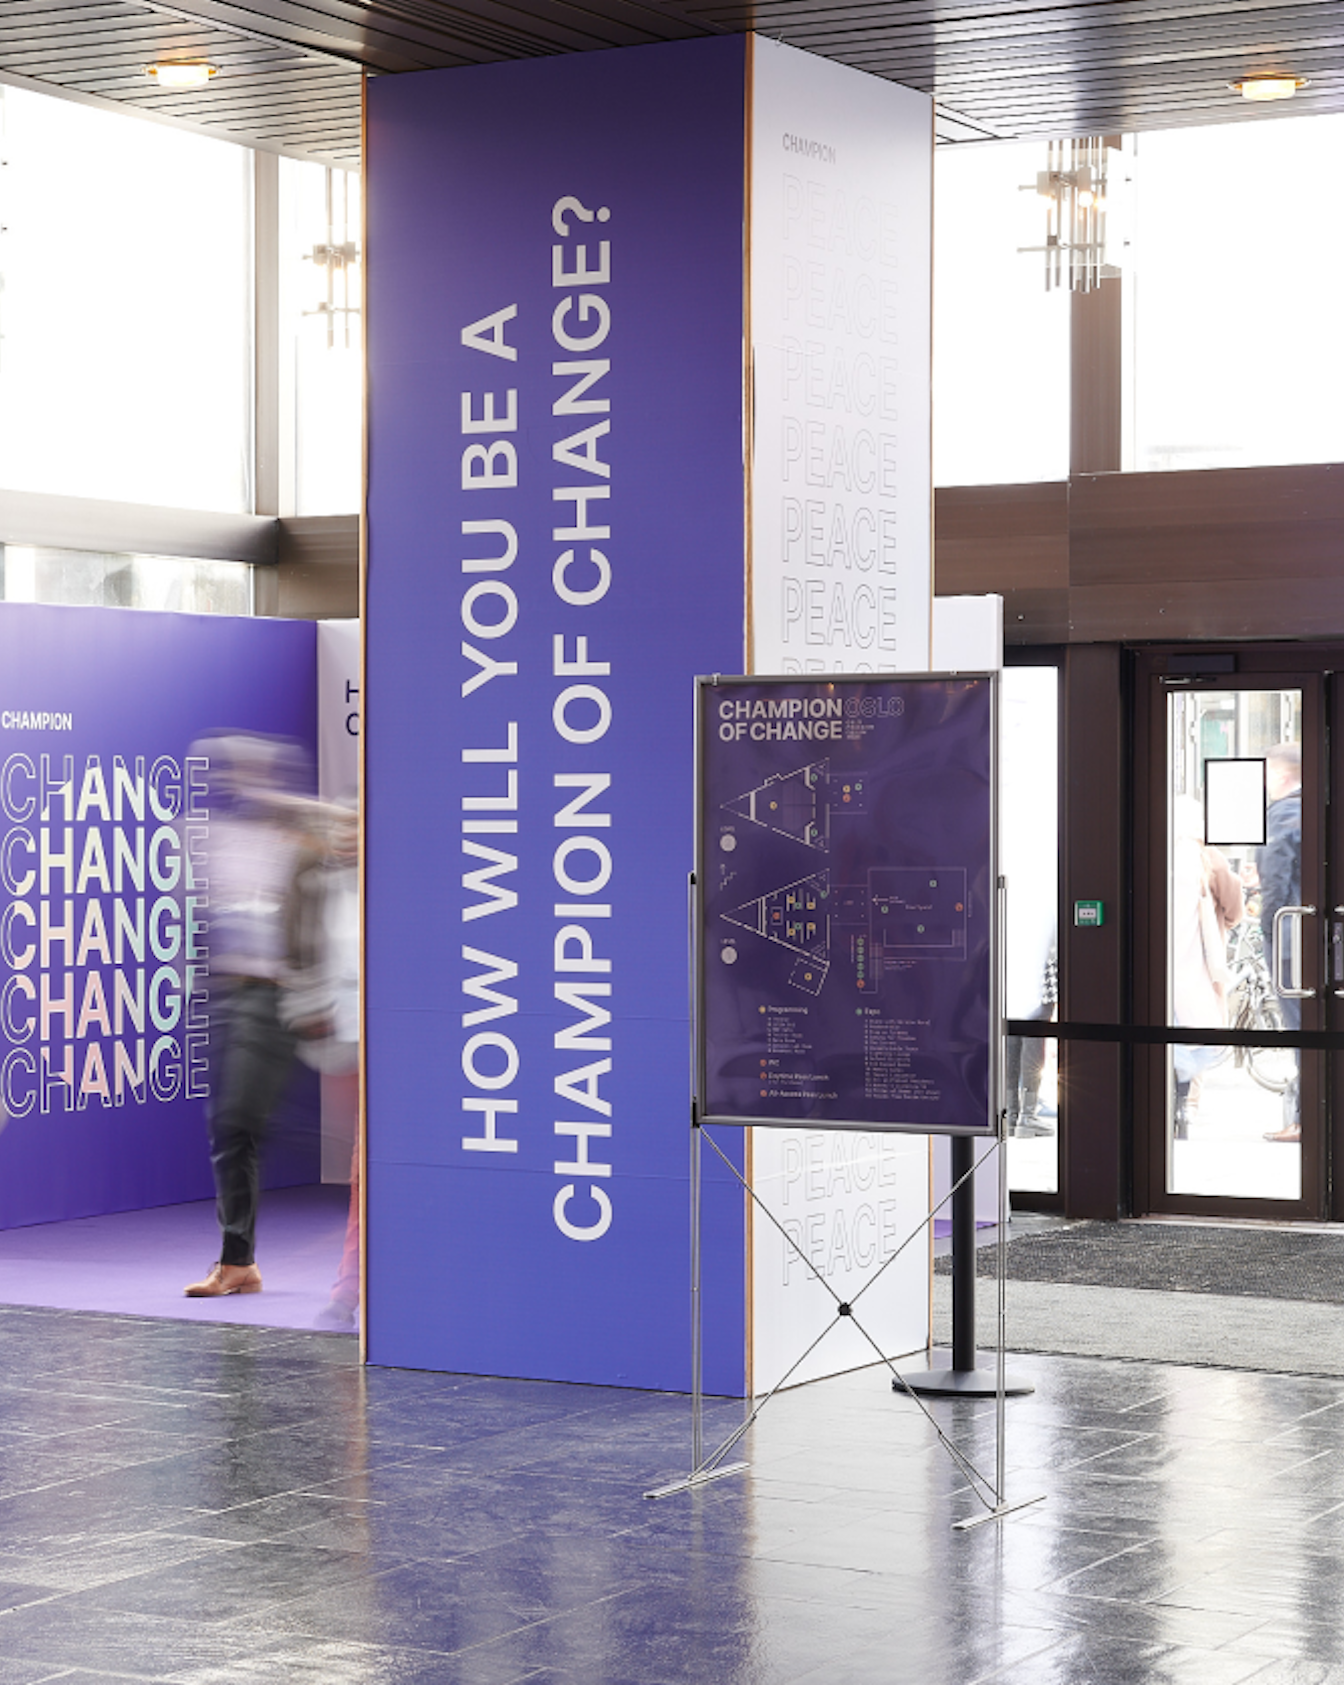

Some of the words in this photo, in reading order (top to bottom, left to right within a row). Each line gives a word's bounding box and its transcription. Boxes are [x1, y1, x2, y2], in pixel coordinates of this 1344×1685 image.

[782, 132, 836, 164] CHAMPION
[461, 303, 518, 361] A
[782, 253, 898, 344] PEACE
[552, 195, 612, 606] CHANGE?
[782, 335, 898, 420] PEACE
[461, 389, 518, 490] BE
[782, 416, 898, 497] PEACE
[782, 497, 898, 574] PEACE
[461, 519, 519, 698] YOU
[782, 577, 898, 650] PEACE
[1, 711, 72, 730] CHAMPION
[553, 633, 612, 744] OF
[719, 699, 843, 719] CHAMPION
[719, 722, 747, 741] OF
[750, 721, 843, 740] CHANGE
[0, 753, 209, 823] CHANGE
[461, 722, 518, 922] WILL
[0, 826, 209, 897] CHANGE
[0, 895, 209, 970] CHANGE
[0, 964, 209, 1044] CHANGE
[553, 773, 613, 1241] CHAMPION
[0, 1033, 209, 1117] CHANGE
[461, 945, 519, 1153] HOW
[783, 1133, 896, 1205] PEACE
[783, 1199, 896, 1286] PEACE
